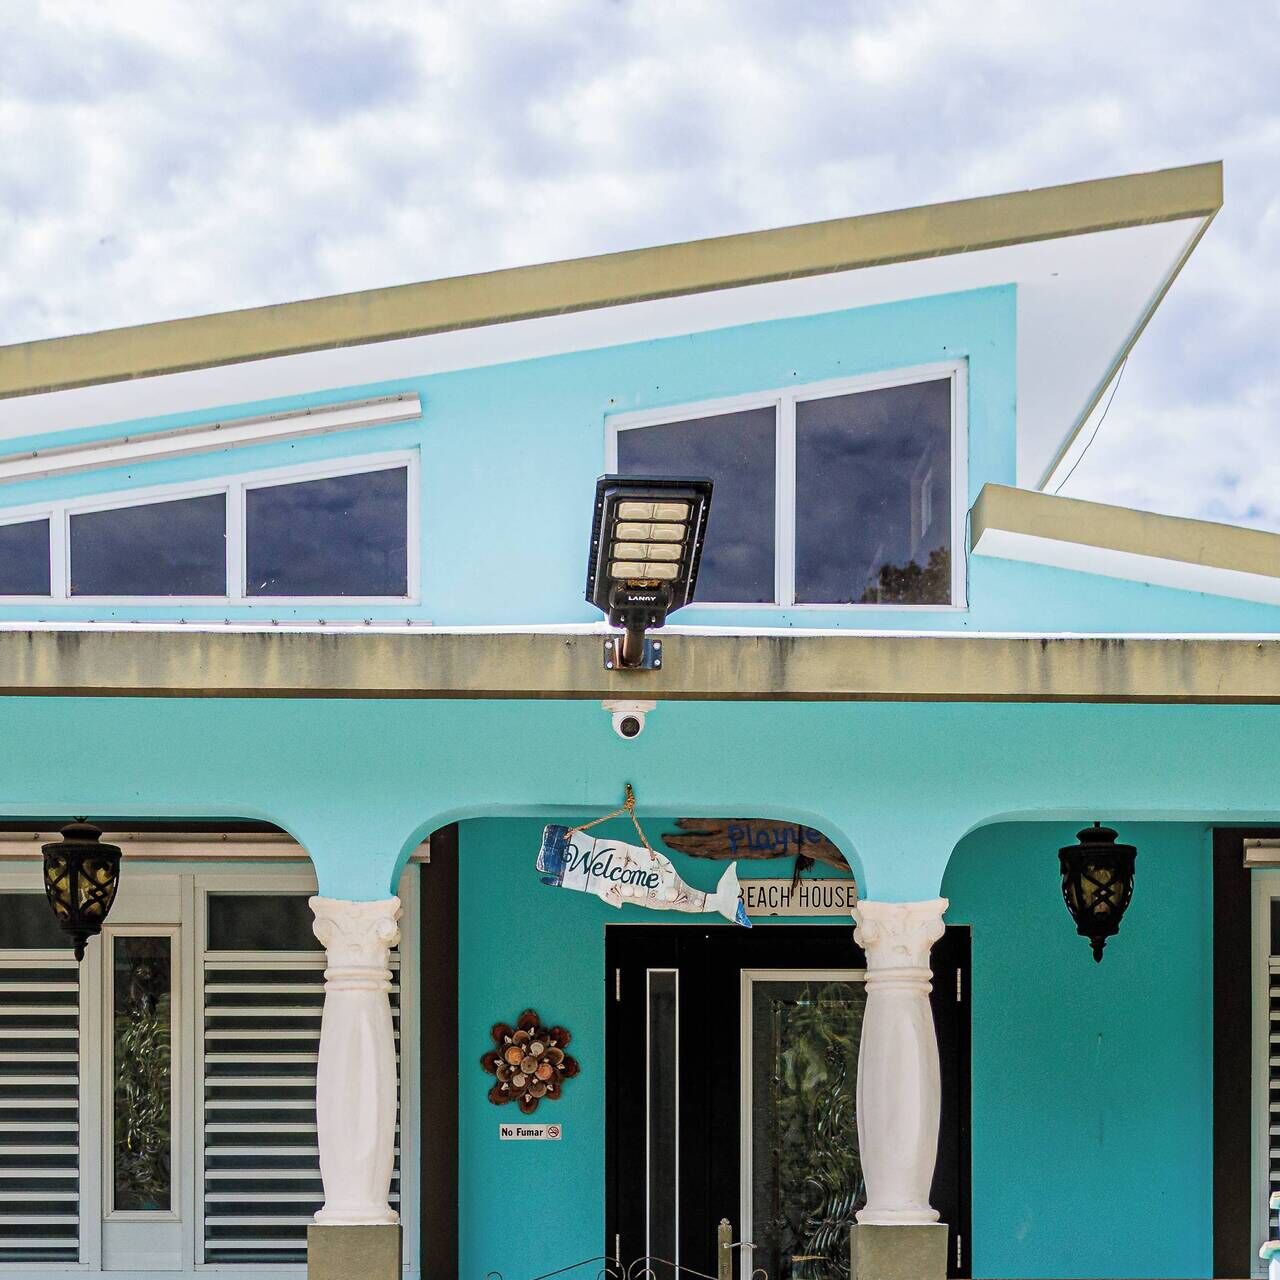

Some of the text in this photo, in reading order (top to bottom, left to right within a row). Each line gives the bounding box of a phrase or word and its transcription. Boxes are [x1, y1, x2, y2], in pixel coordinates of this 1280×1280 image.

[727, 823, 823, 857] Playue
[560, 842, 659, 888] Welcome
[799, 885, 855, 908] HOUSE
[501, 1127, 543, 1137] No Fumar
